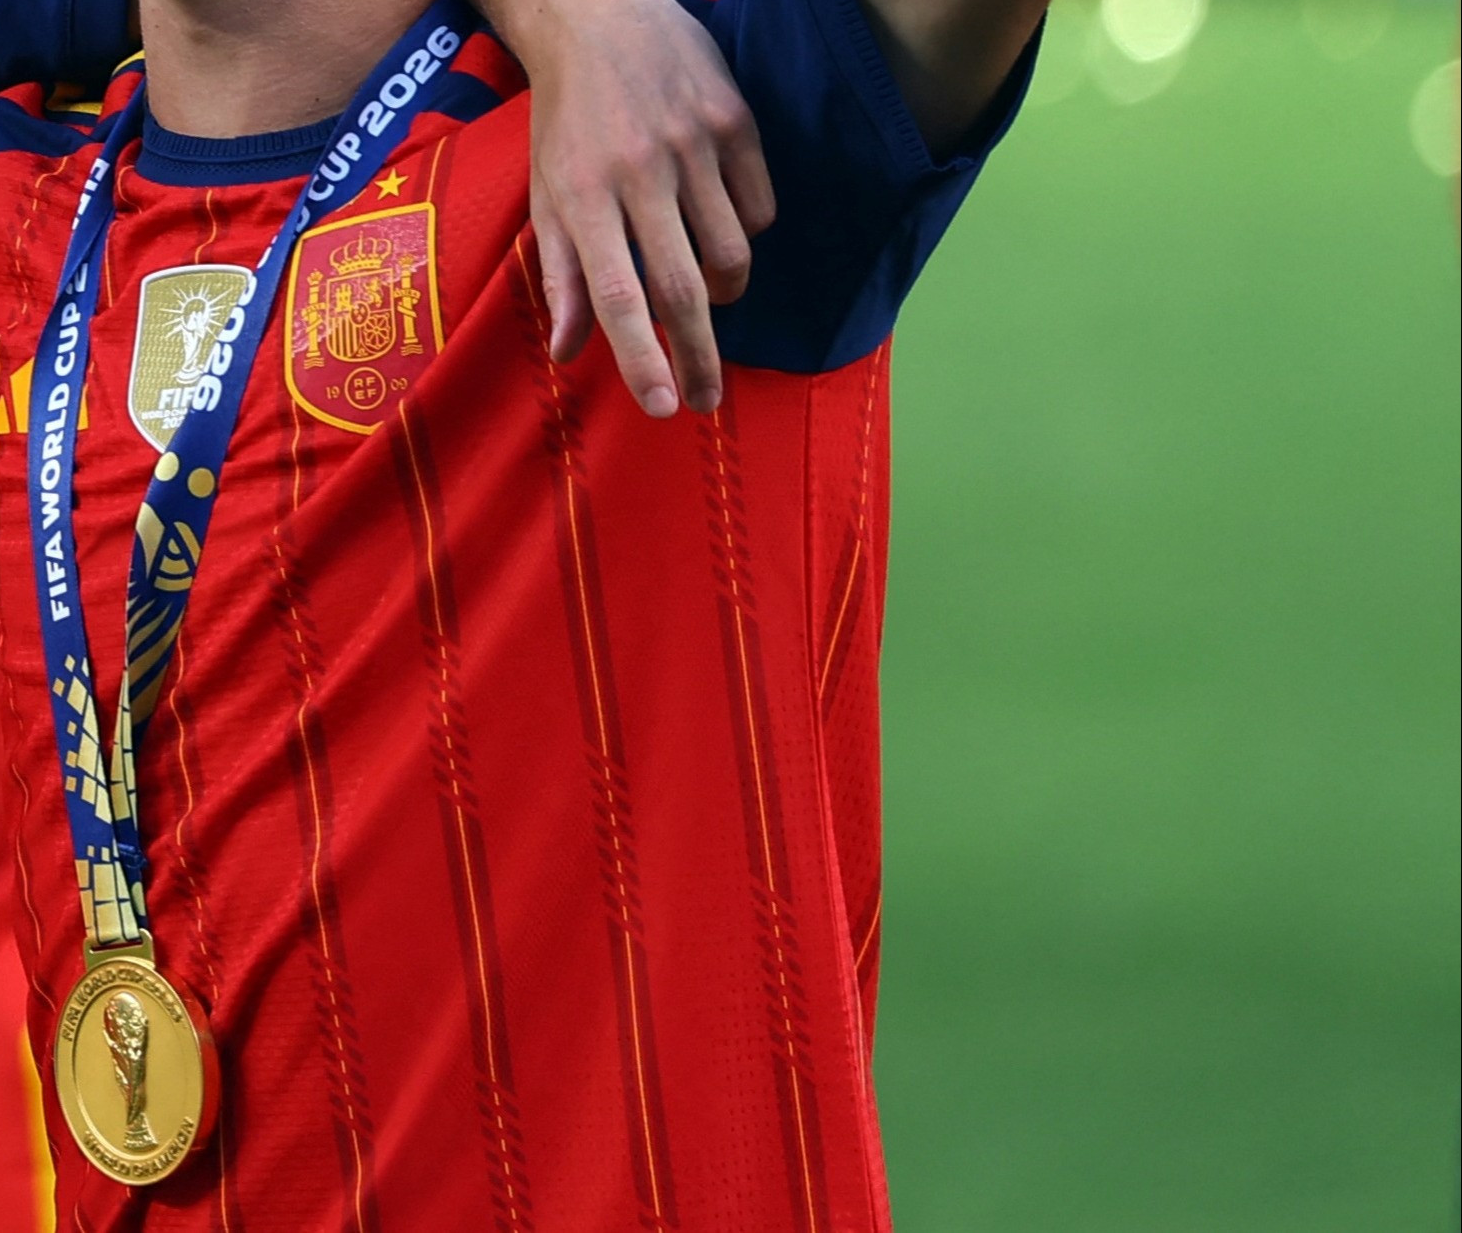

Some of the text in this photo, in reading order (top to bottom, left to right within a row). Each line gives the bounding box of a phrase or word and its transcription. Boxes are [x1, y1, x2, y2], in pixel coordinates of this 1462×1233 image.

[307, 25, 461, 202] CUP 2026
[54, 302, 81, 377] CUP
[158, 386, 196, 410] FIF
[40, 382, 70, 530] WORLD
[45, 530, 71, 622] FIFA
